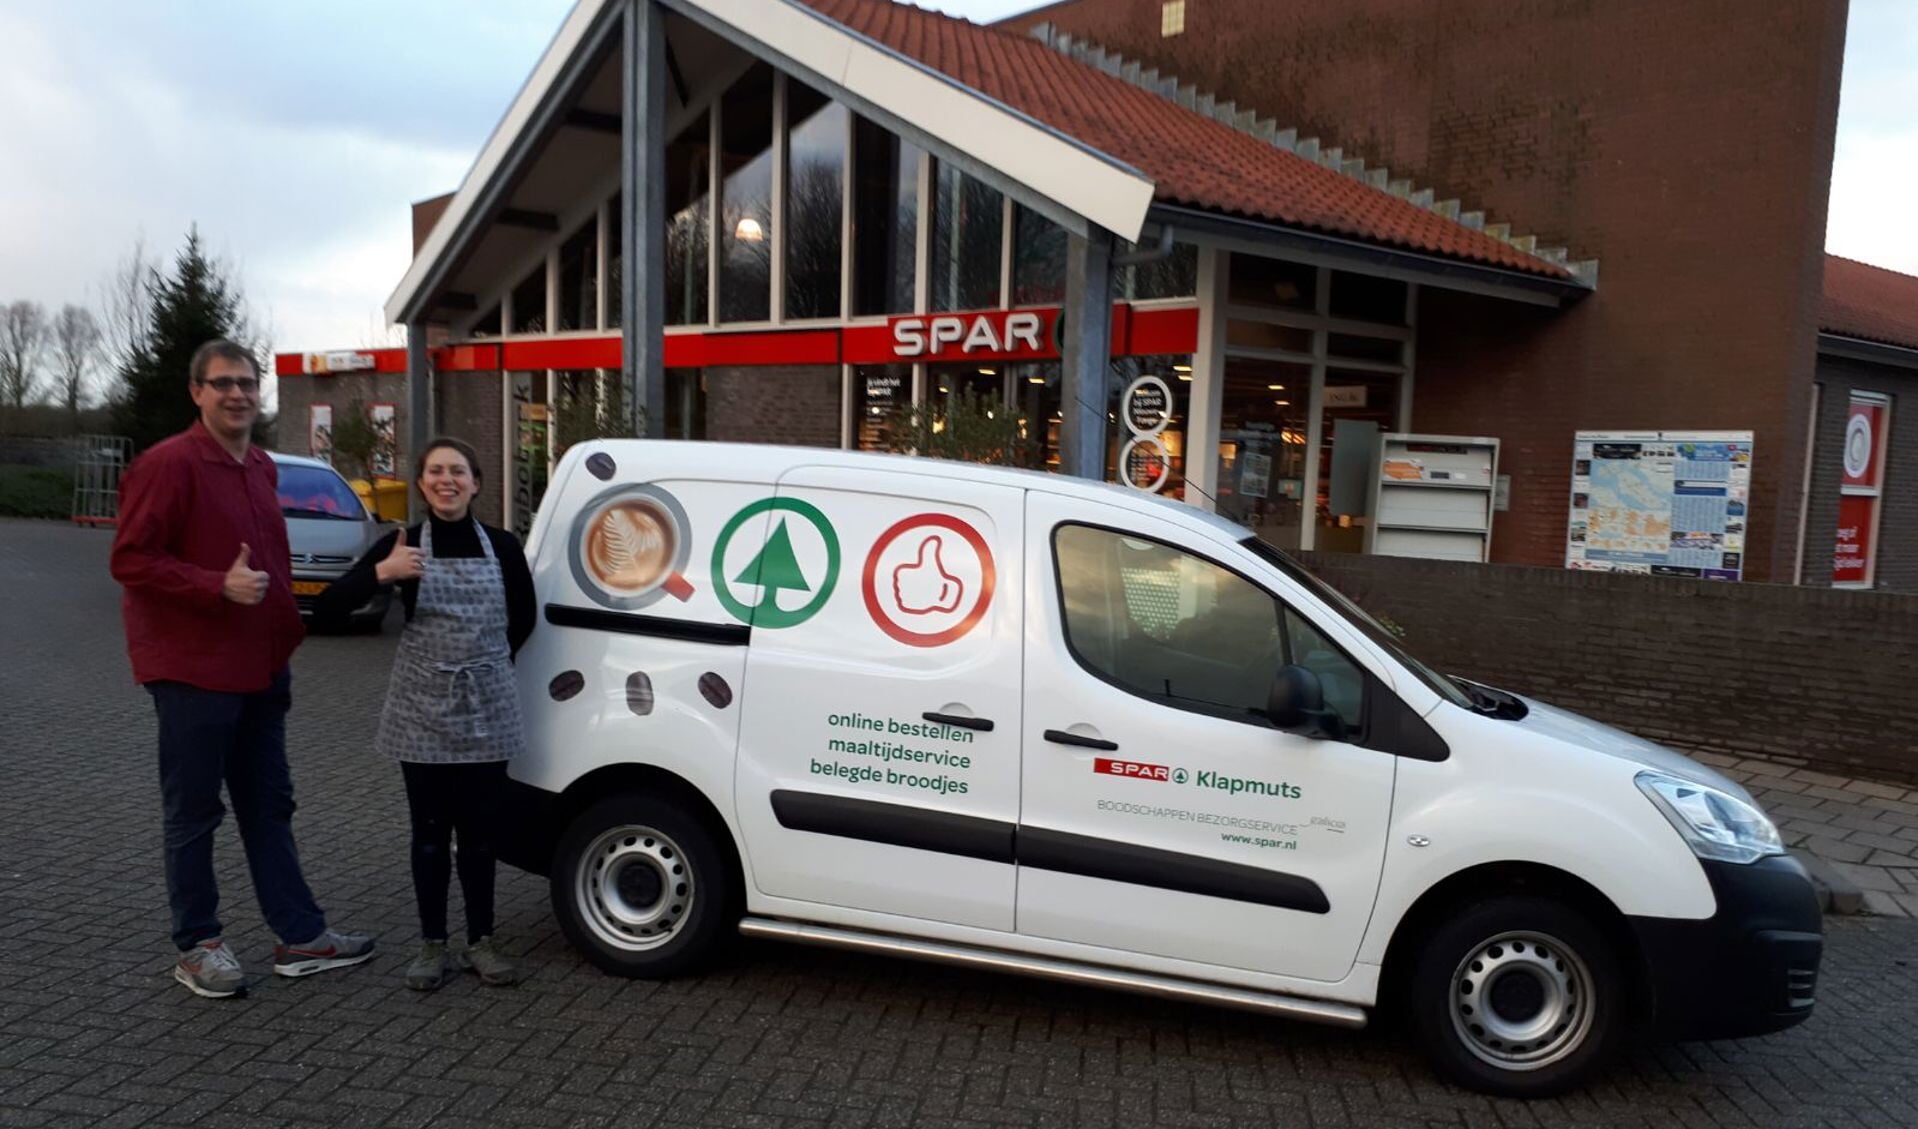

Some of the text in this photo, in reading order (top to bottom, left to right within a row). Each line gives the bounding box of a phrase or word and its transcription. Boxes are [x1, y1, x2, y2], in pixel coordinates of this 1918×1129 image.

[893, 312, 1040, 356] SPAR
[828, 712, 974, 743] online bestellen
[828, 738, 971, 768] maaltijdservice
[810, 758, 969, 795] belegde broodjes
[1110, 761, 1302, 799] SPAR Klapmuts
[1097, 799, 1298, 836] BOODSCHAPPEN BEZORGSERVICE
[1221, 832, 1297, 851] www.spar.nl
